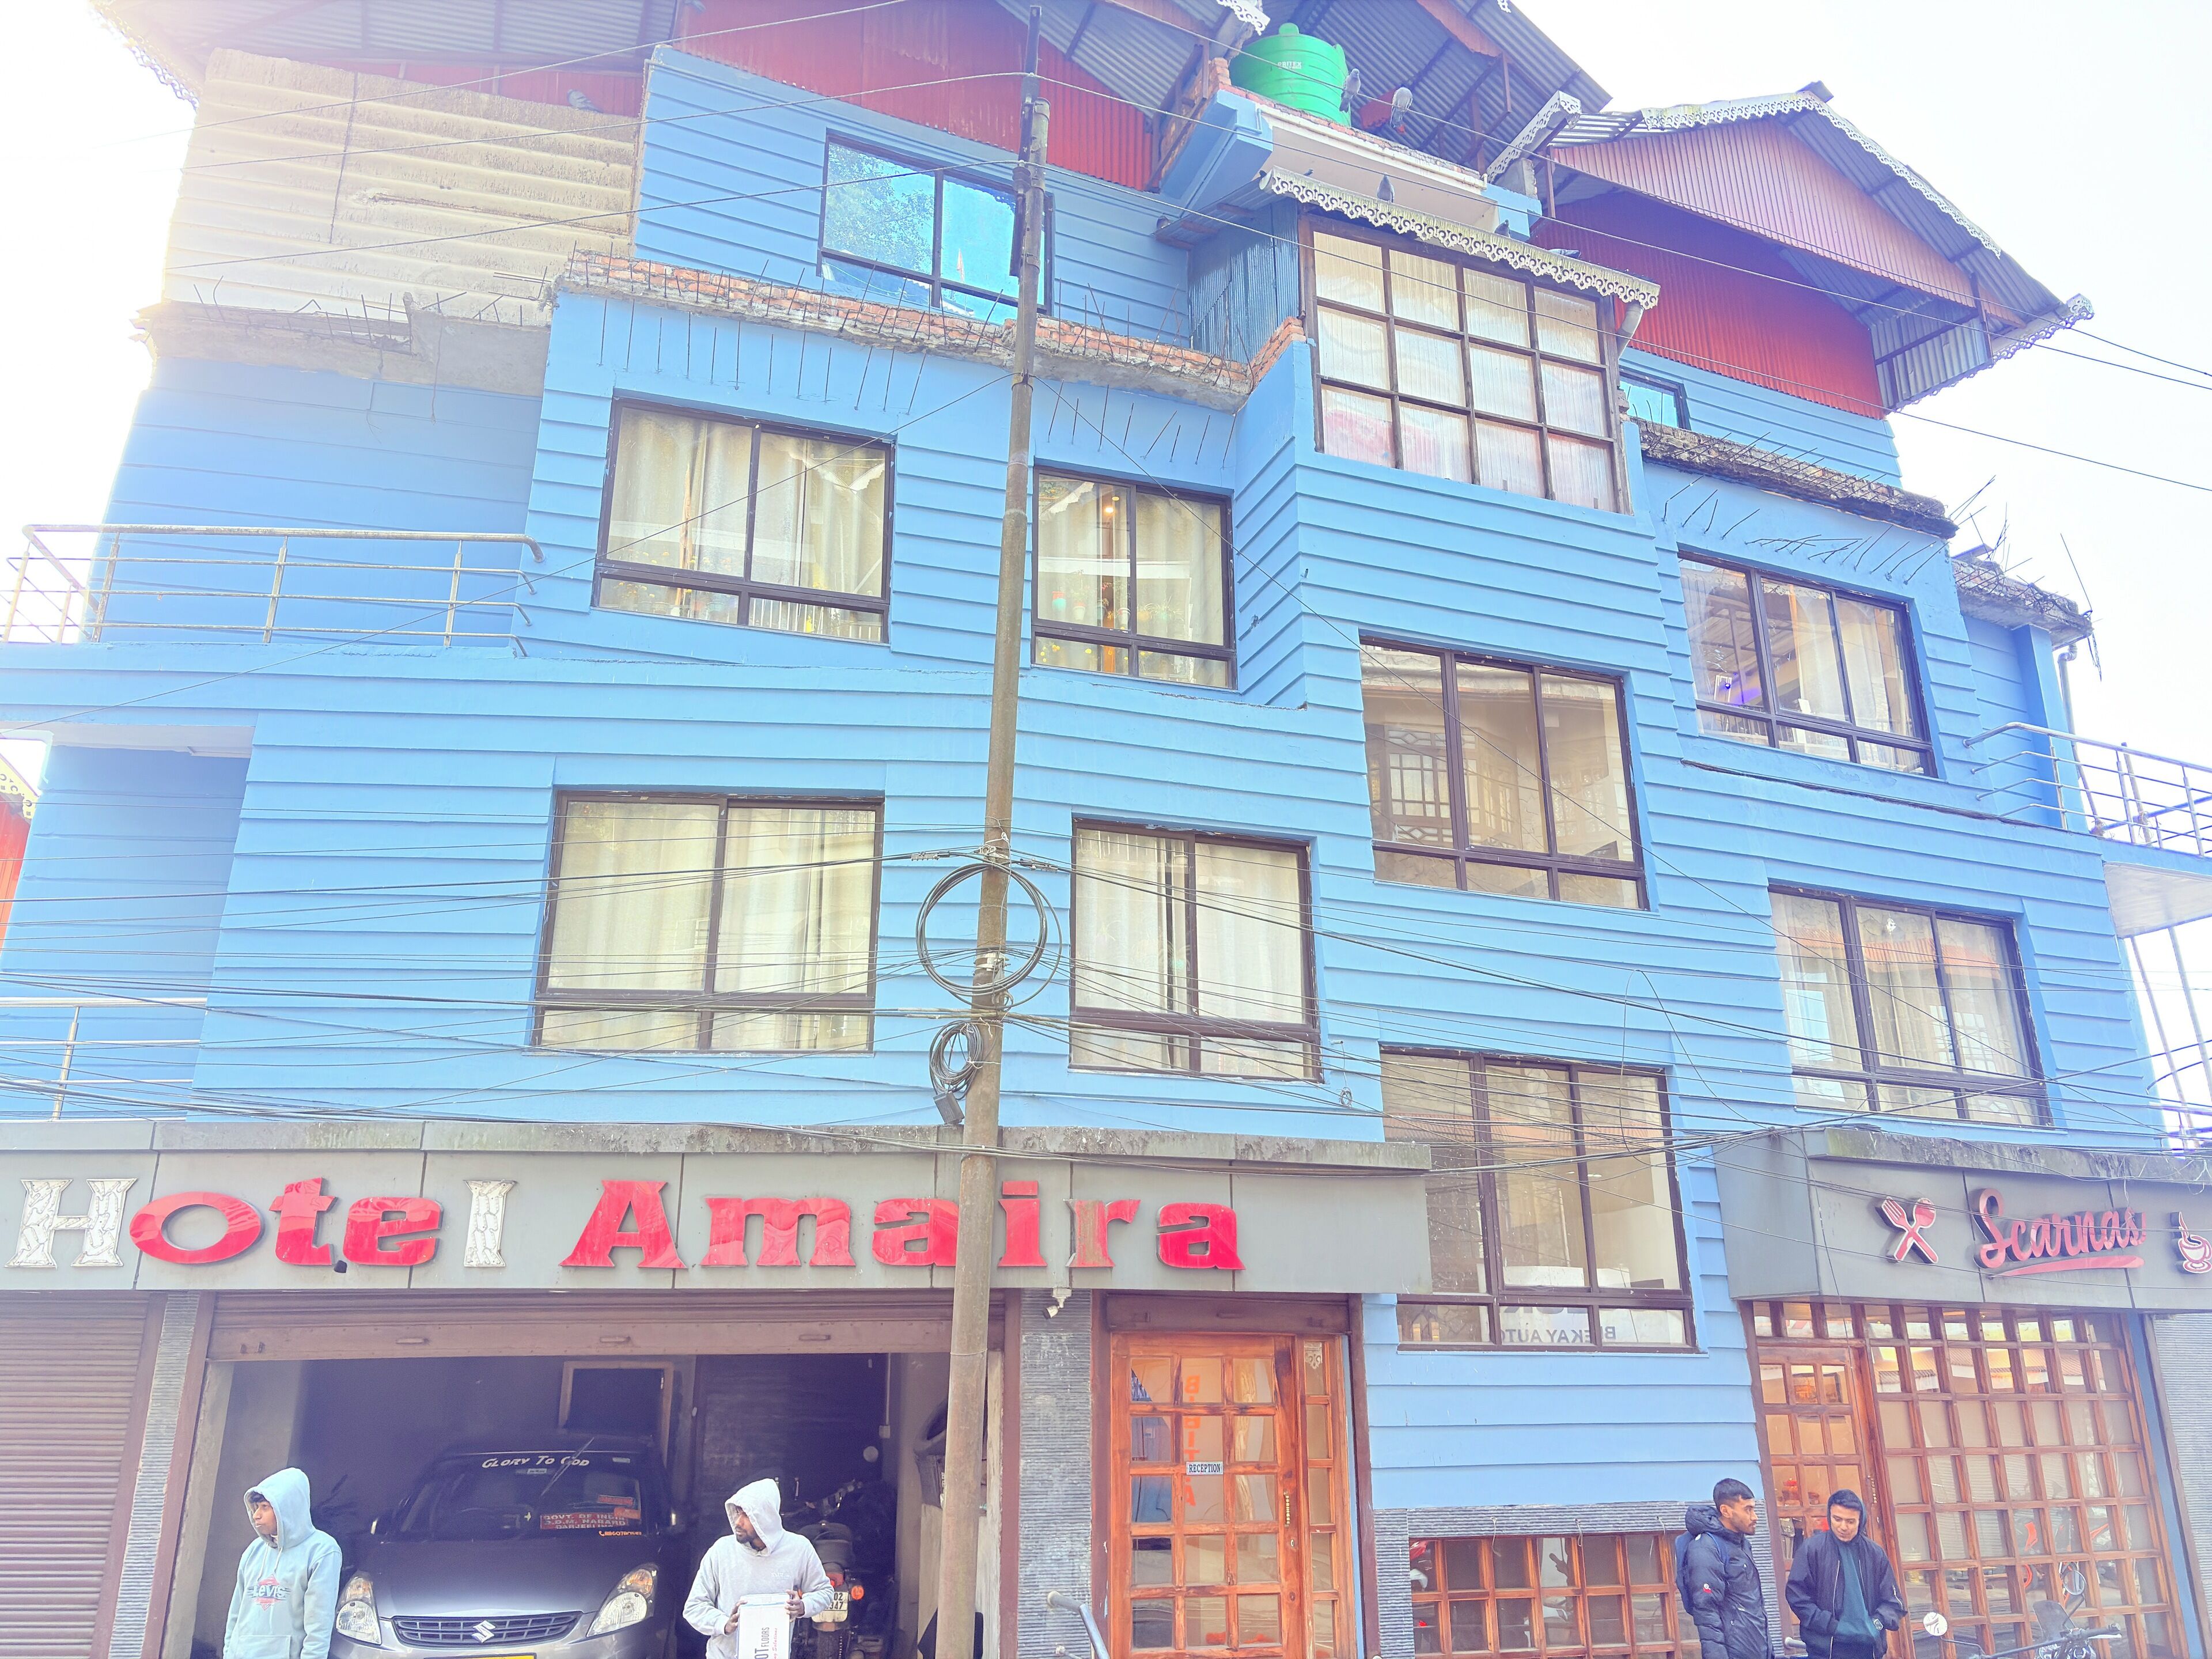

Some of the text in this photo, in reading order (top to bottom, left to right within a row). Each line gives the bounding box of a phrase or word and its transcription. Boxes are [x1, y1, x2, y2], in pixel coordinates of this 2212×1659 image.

[4, 1177, 1247, 1271] Hotel Amaira
[1188, 1463, 1221, 1473] RECEPTION
[761, 1627, 770, 1647] FLOORS
